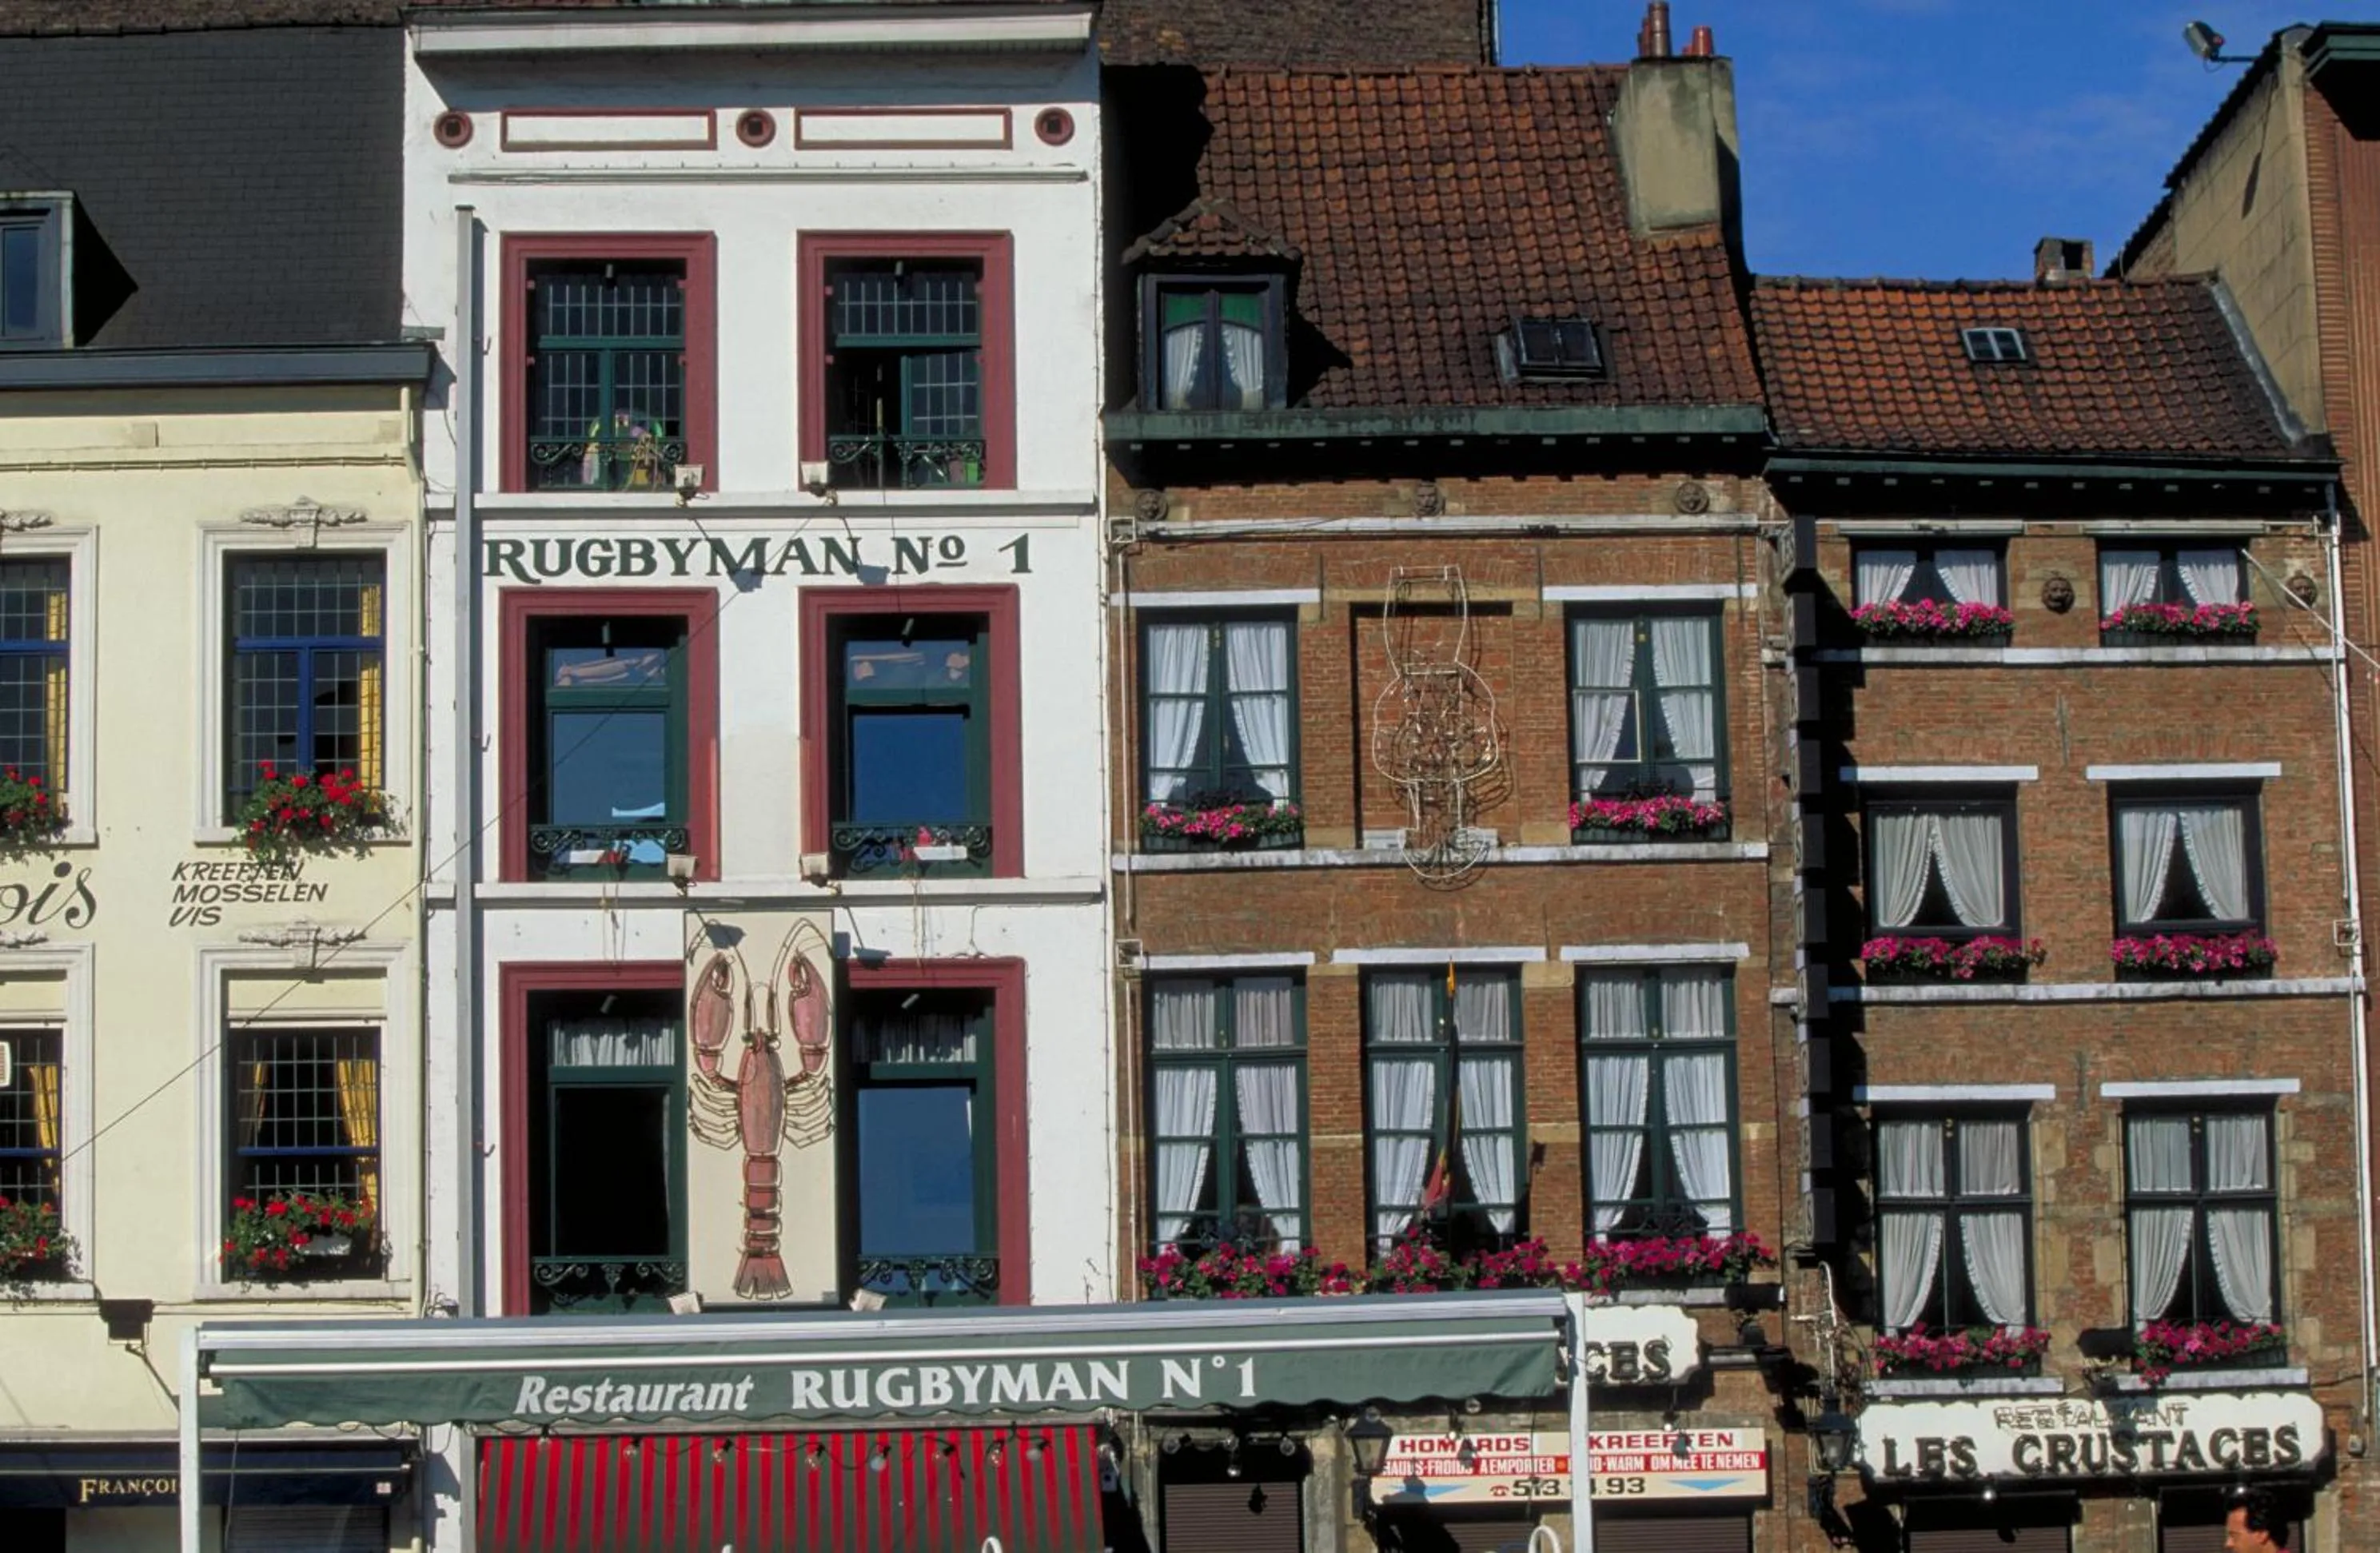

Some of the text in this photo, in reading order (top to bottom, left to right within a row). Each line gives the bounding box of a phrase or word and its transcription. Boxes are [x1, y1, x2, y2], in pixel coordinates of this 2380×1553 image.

[482, 536, 862, 585] RUGBYMAN
[998, 532, 1033, 574] 1
[171, 858, 305, 882] KREEFTEN
[172, 882, 329, 904] MOSSELEN
[169, 905, 222, 927] VIS
[513, 1373, 754, 1415] Restaurant
[791, 1360, 1130, 1410] RUGBYMAN
[1994, 1402, 2189, 1431] RESTAUANT
[1589, 1433, 1734, 1449] KREEFEN
[1882, 1424, 2302, 1475] LES CRUSTACES
[79, 1478, 177, 1503] FRANÇOI
